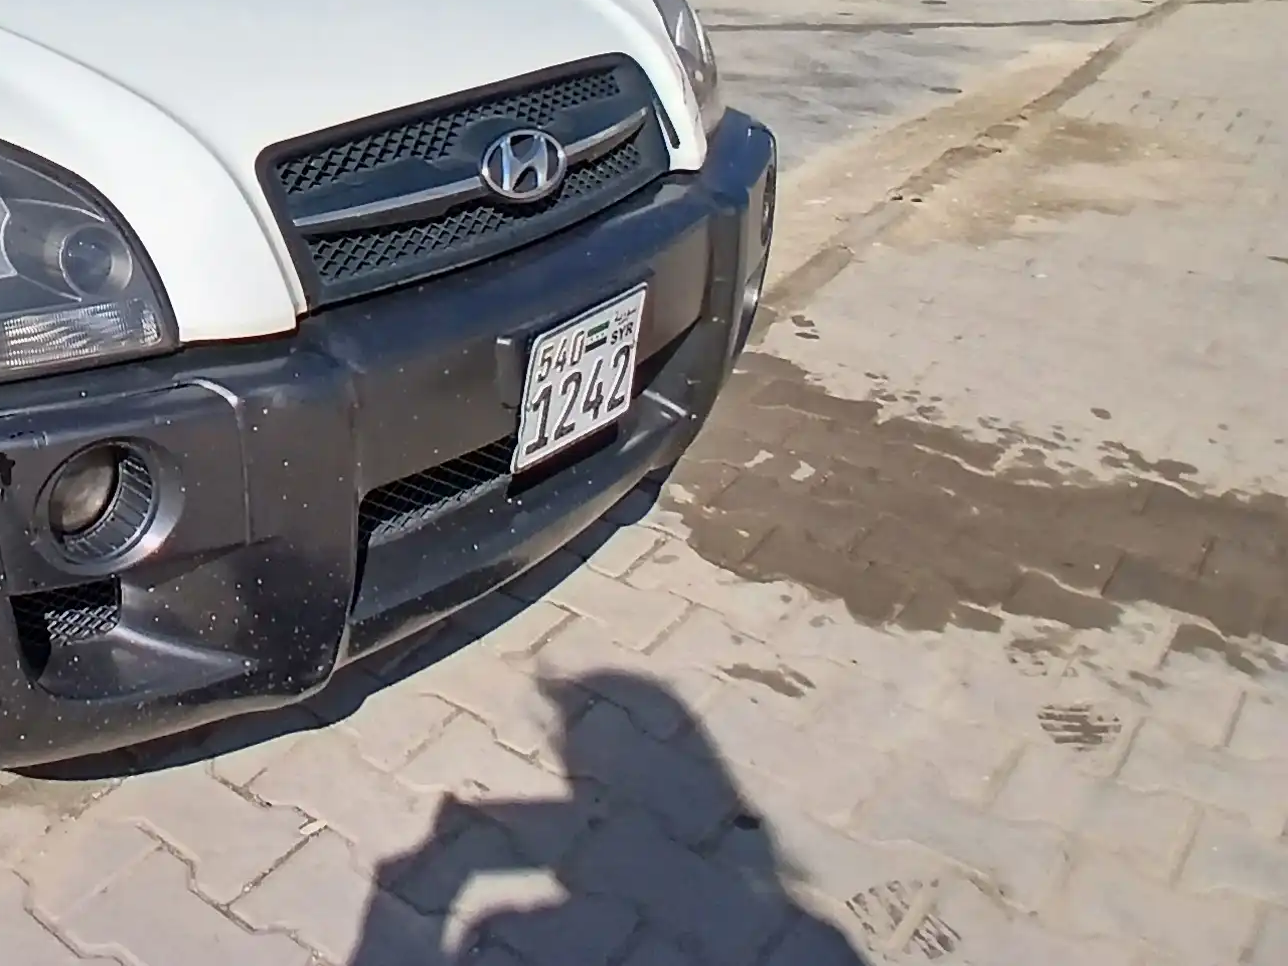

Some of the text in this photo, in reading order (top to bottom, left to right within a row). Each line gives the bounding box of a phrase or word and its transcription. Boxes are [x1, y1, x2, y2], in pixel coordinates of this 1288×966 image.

[535, 330, 585, 382] 540
[610, 322, 633, 345] SYR
[524, 344, 630, 455] 1242
